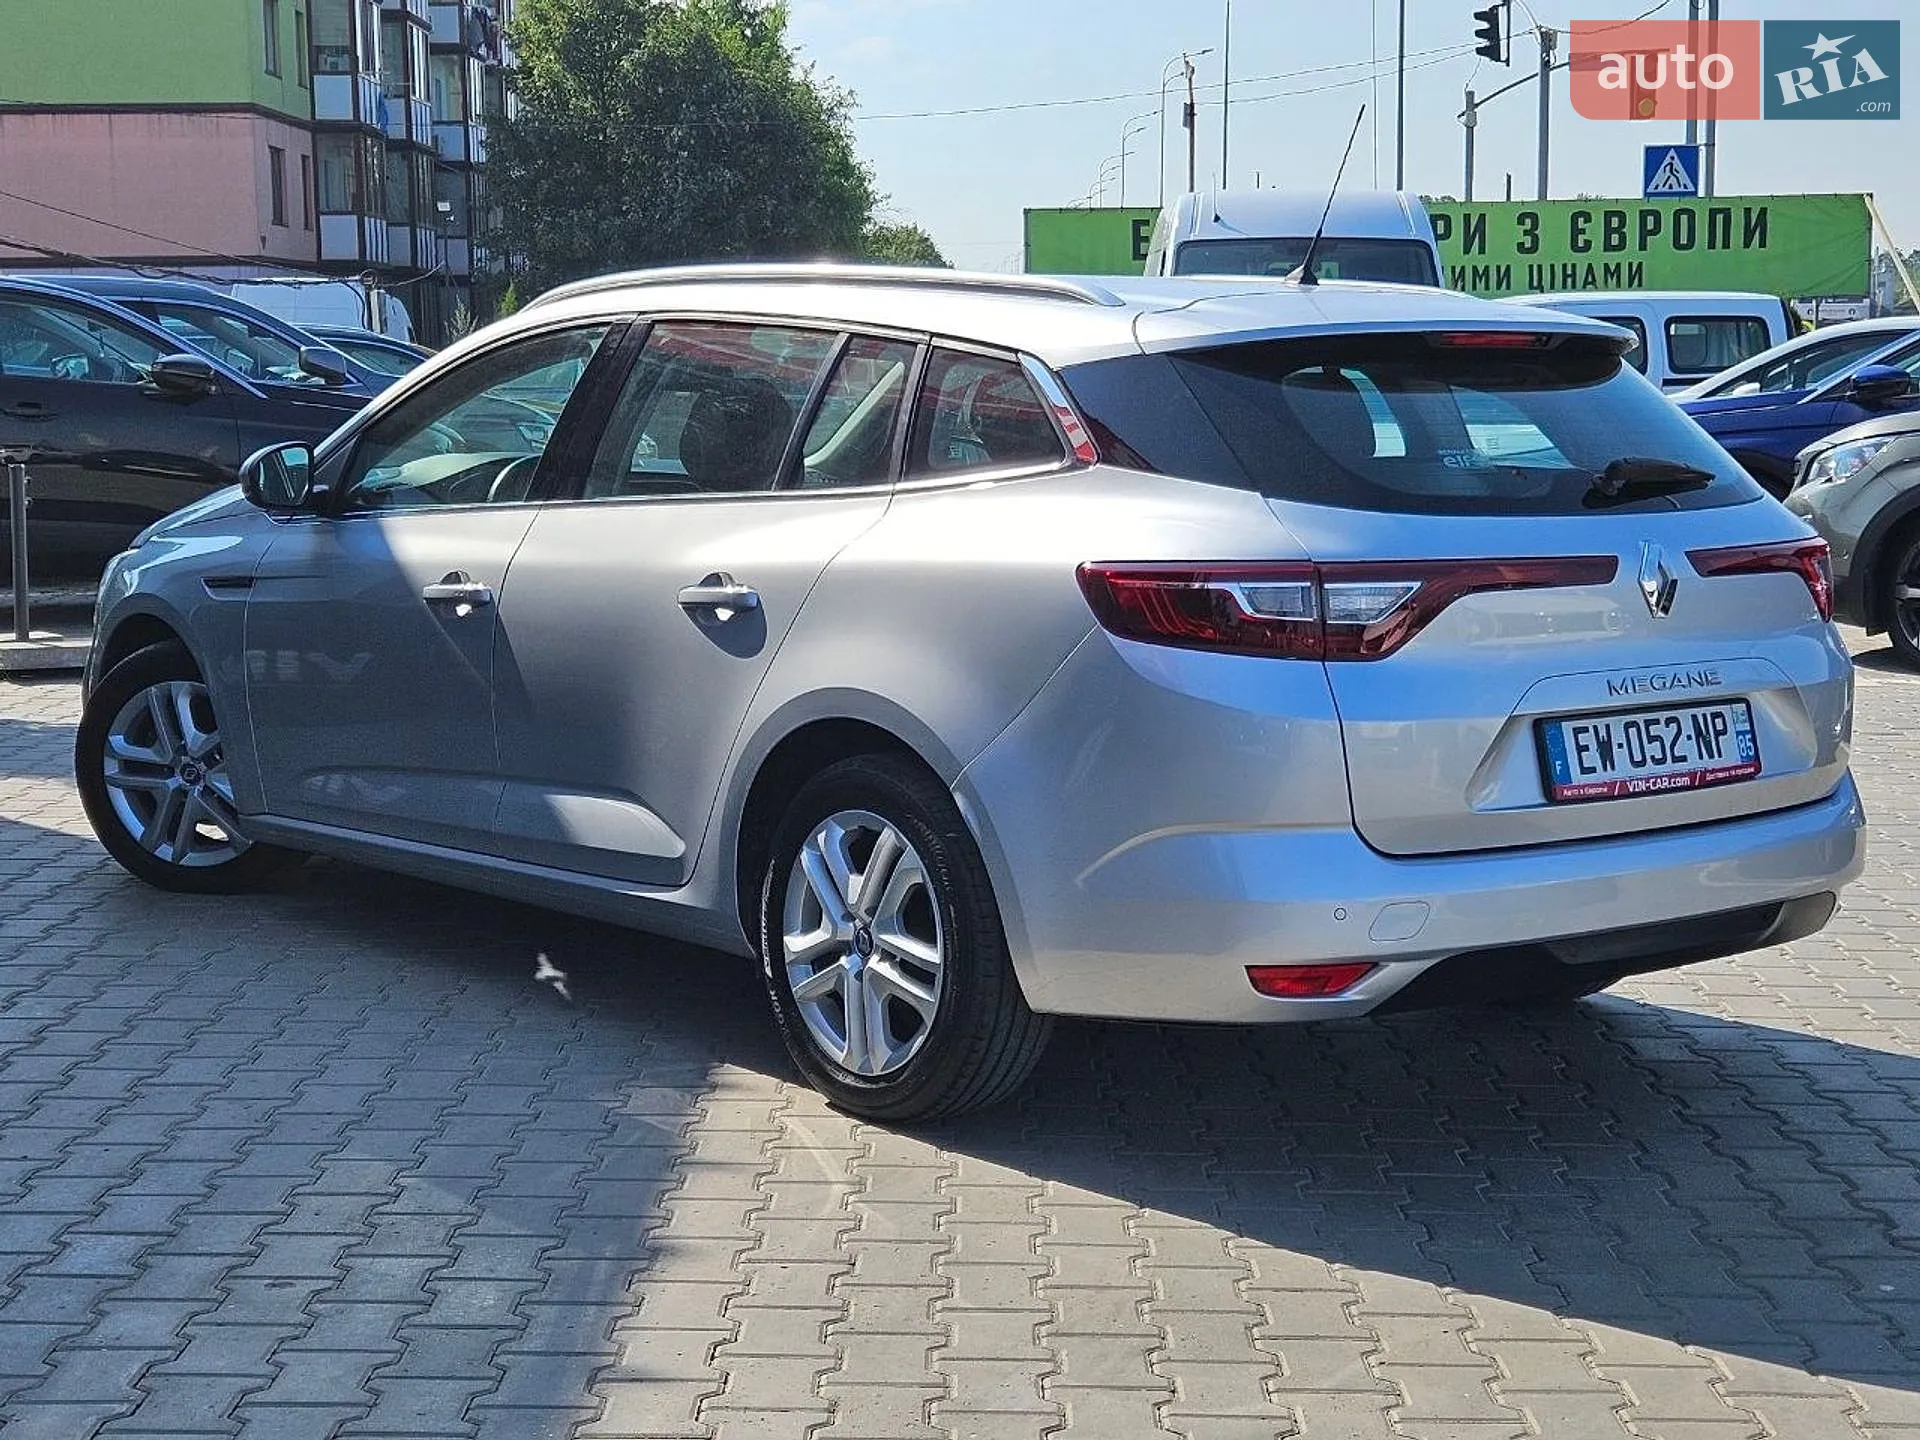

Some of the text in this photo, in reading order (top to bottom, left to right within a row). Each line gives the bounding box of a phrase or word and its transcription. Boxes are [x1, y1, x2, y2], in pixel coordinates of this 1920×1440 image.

[1516, 211, 1541, 255] З
[1569, 206, 1769, 254] ЄВРОПИ
[1527, 260, 1644, 294] ЦІНАМИ
[1606, 669, 1722, 697] MEGANE
[1571, 710, 1729, 776] EW-052-NP
[1738, 734, 1755, 758] 85
[1626, 776, 1691, 793] VIN-CAR.com
